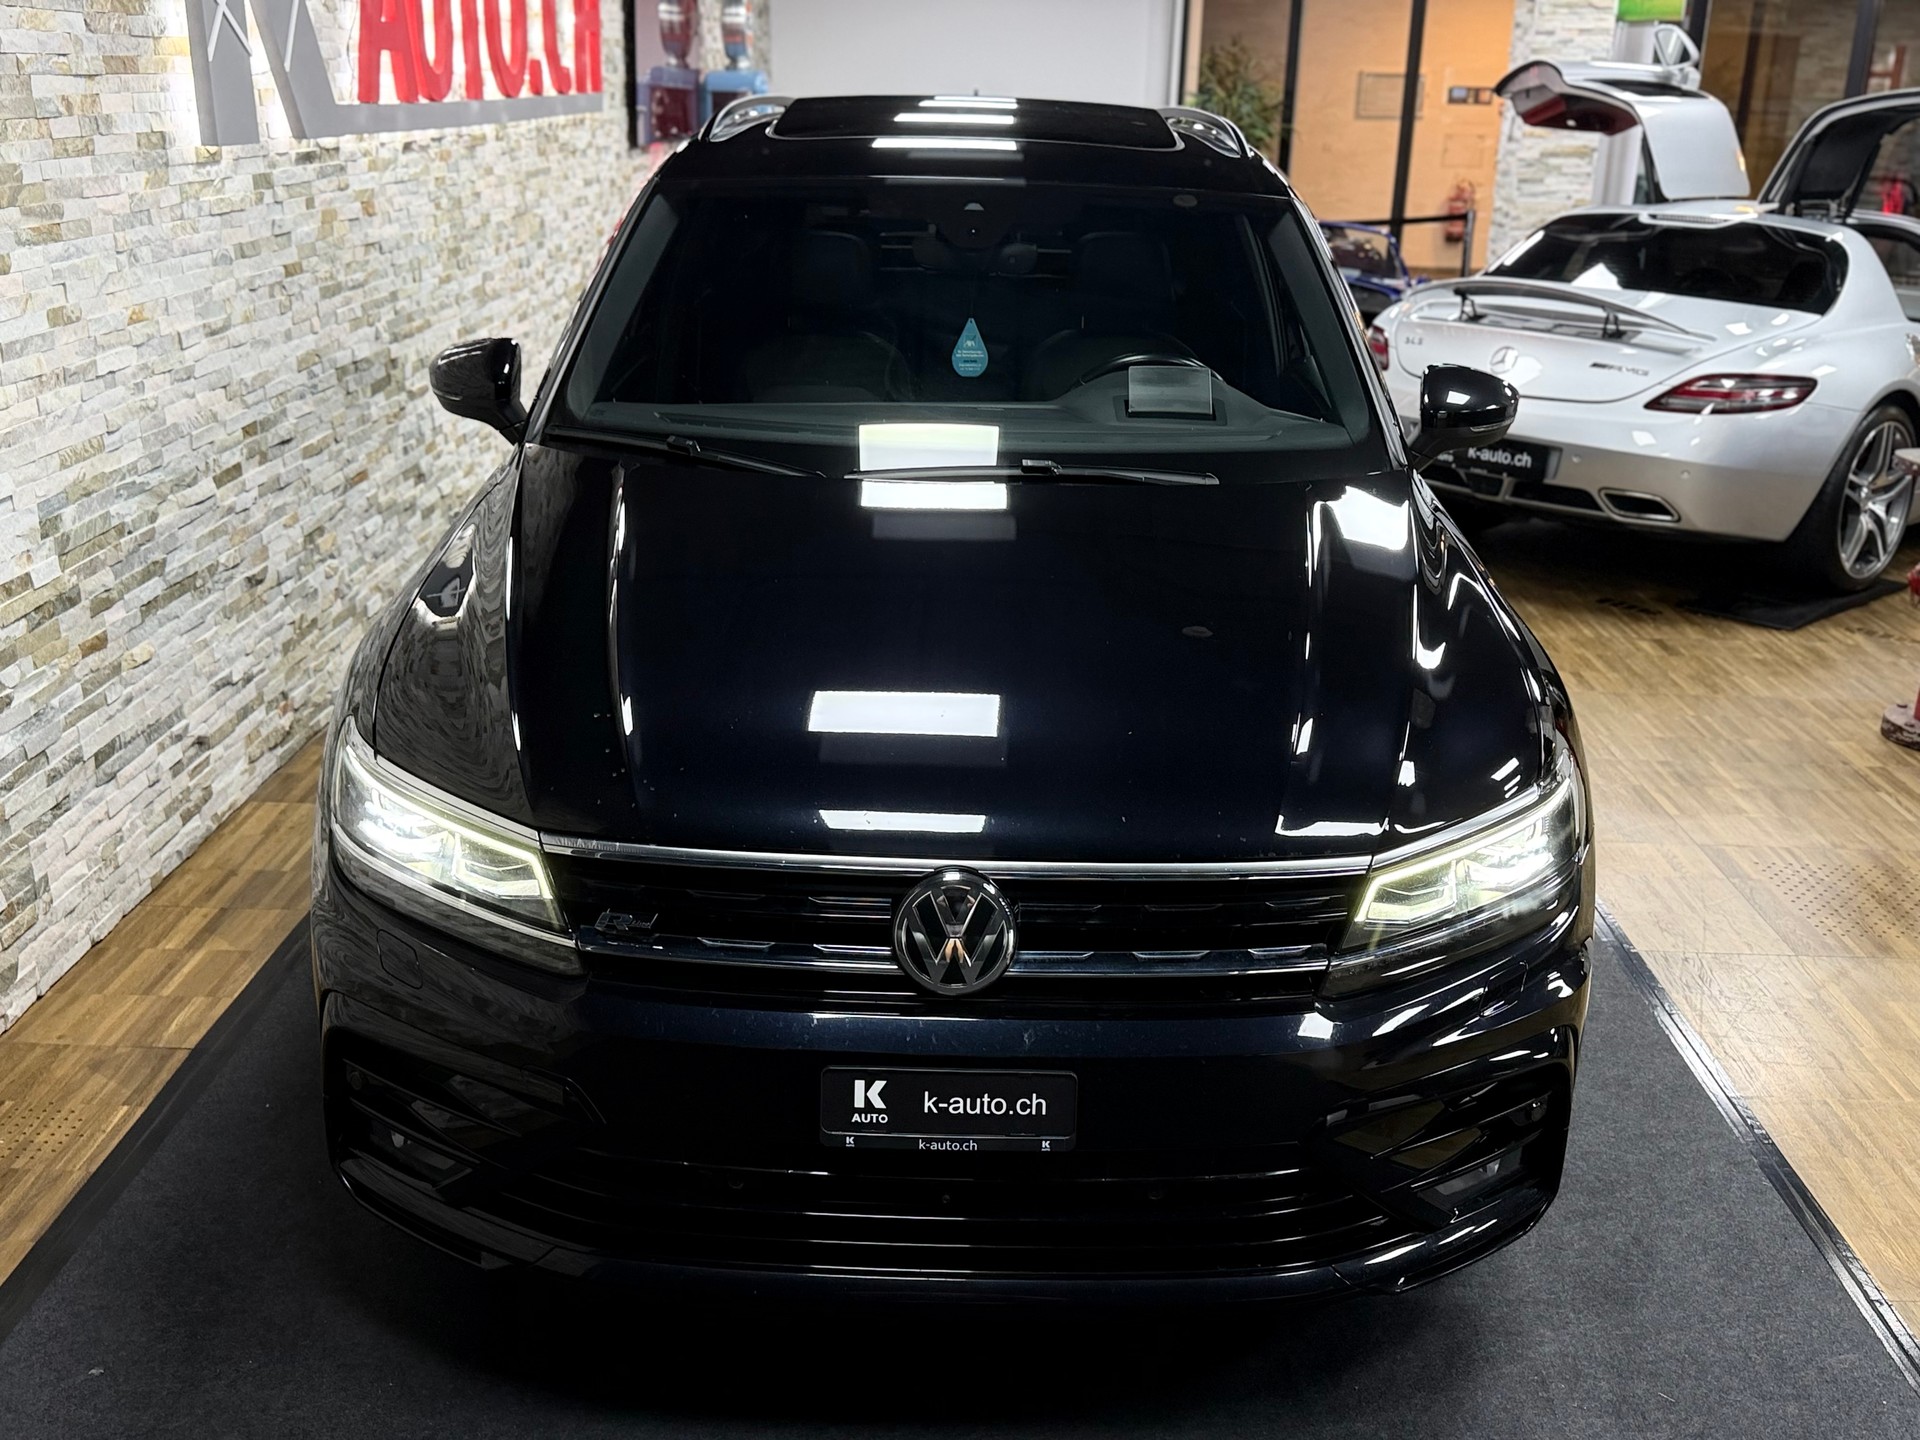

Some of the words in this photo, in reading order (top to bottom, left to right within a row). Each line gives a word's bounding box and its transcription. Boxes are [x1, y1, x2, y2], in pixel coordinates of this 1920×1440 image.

[853, 1079, 888, 1109] K
[923, 1090, 1047, 1116] k-auto.ch
[851, 1113, 889, 1124] AUTO
[918, 1139, 978, 1151] k-auto.ch
